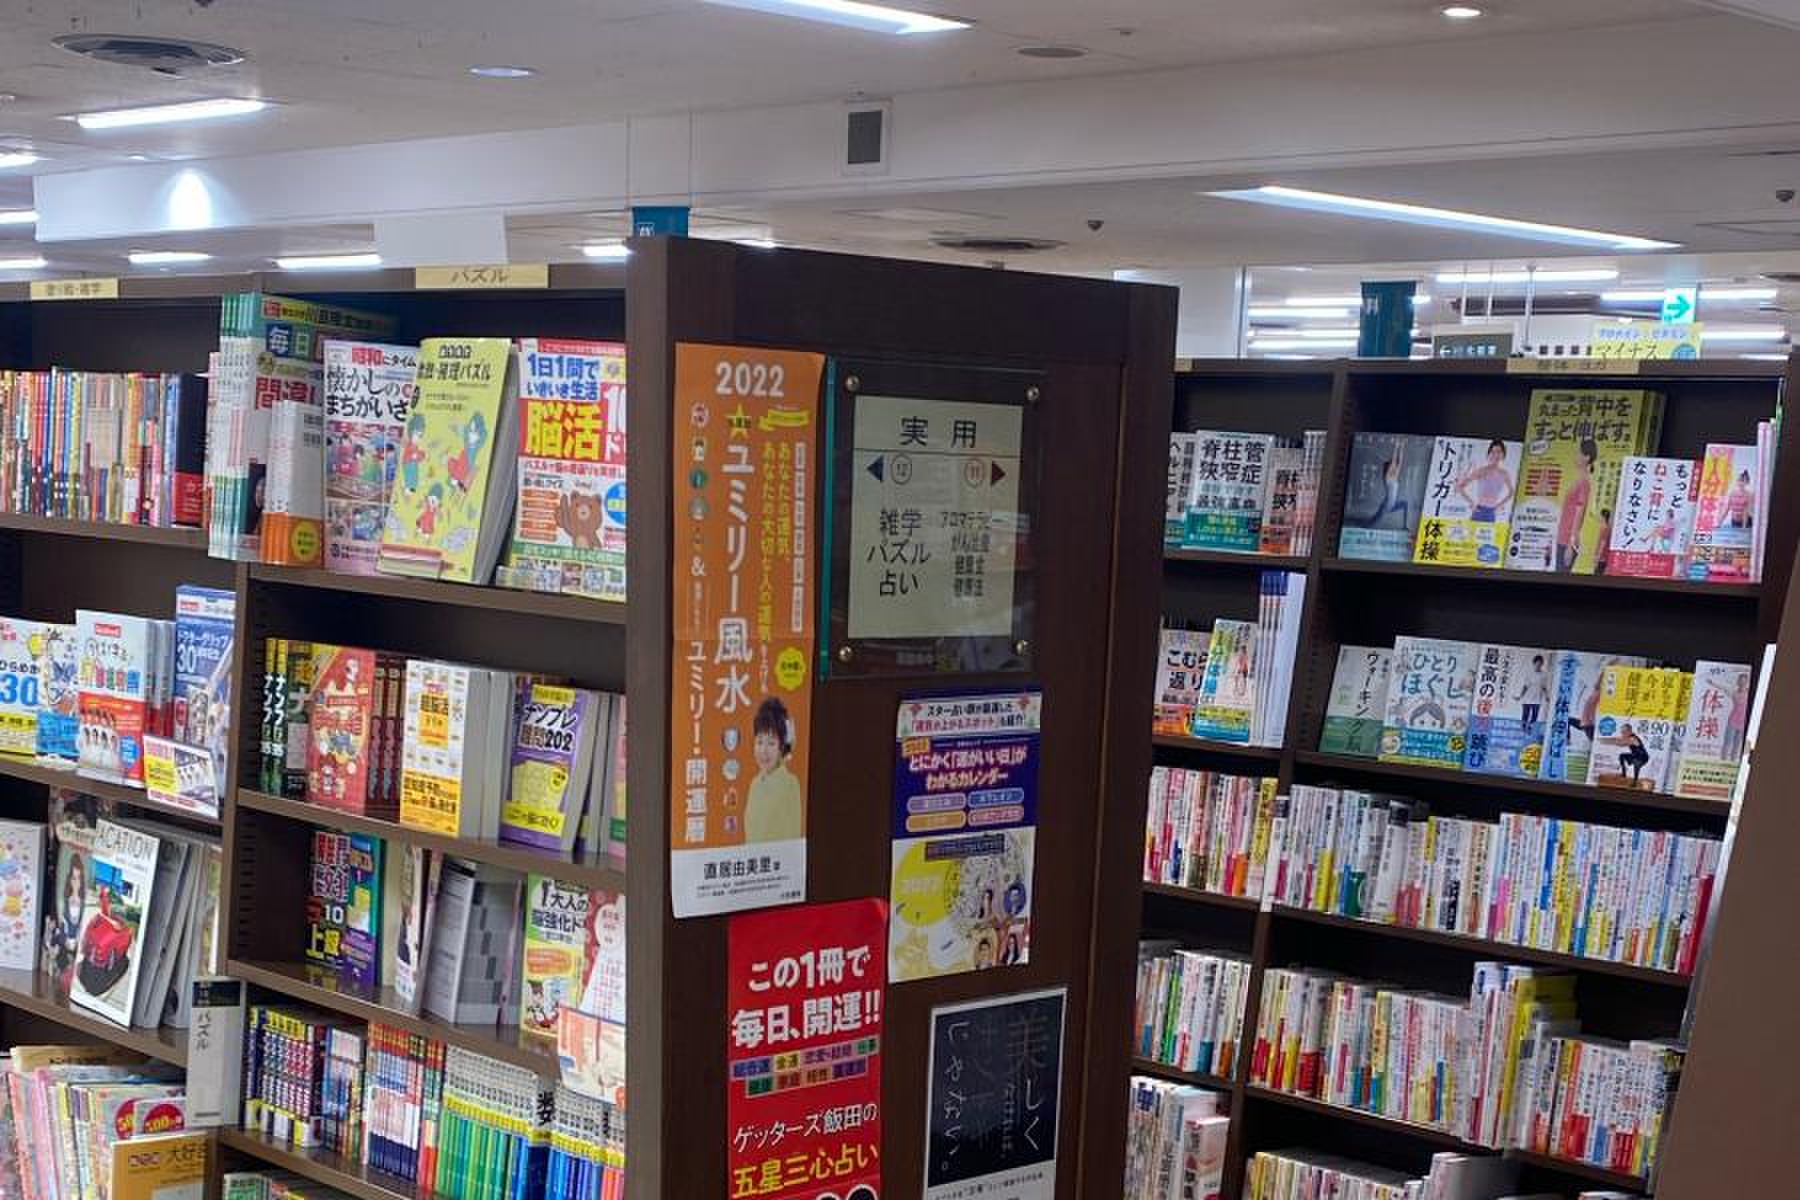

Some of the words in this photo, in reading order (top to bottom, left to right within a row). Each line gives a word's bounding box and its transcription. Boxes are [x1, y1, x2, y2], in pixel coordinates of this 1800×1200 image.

[451, 267, 509, 284] パズル
[715, 361, 785, 398] 2022
[527, 400, 603, 460] 脳活
[1670, 463, 1689, 509] もっと
[878, 507, 923, 538] 雑学
[866, 539, 932, 566] パズル
[878, 570, 920, 598] 占い
[1411, 651, 1458, 674] ひとり
[1400, 672, 1467, 700] ほぐし
[747, 944, 872, 993] この1冊で
[197, 1010, 211, 1051] パズル
[733, 1102, 879, 1153] ゲッターズ飯田の
[732, 1141, 879, 1200] 五星三心占い
